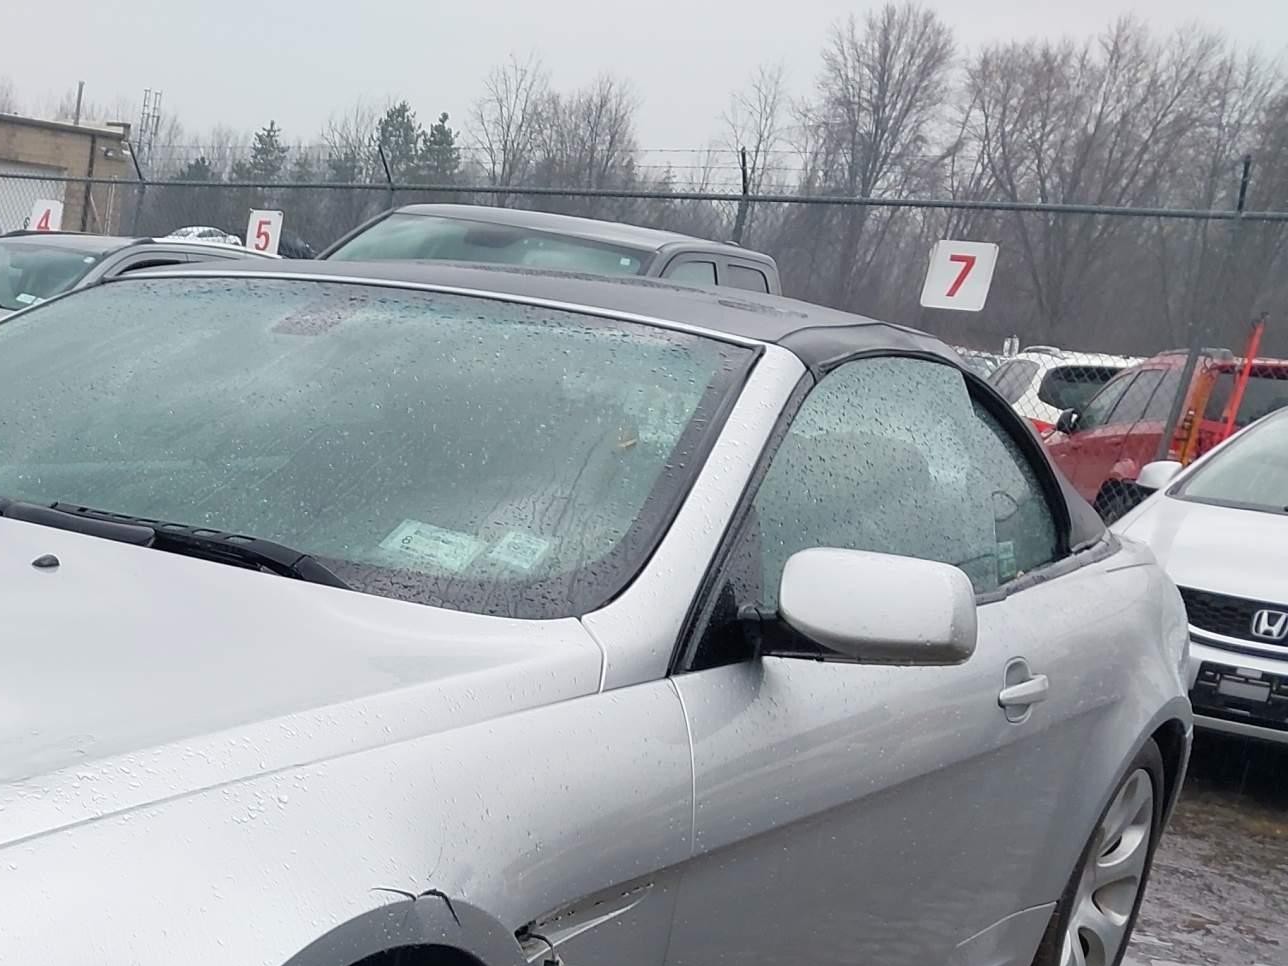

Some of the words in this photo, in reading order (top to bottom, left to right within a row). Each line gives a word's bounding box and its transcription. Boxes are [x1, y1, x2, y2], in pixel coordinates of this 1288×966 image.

[36, 208, 51, 231] 4
[254, 220, 272, 252] 5
[945, 254, 976, 297] 7
